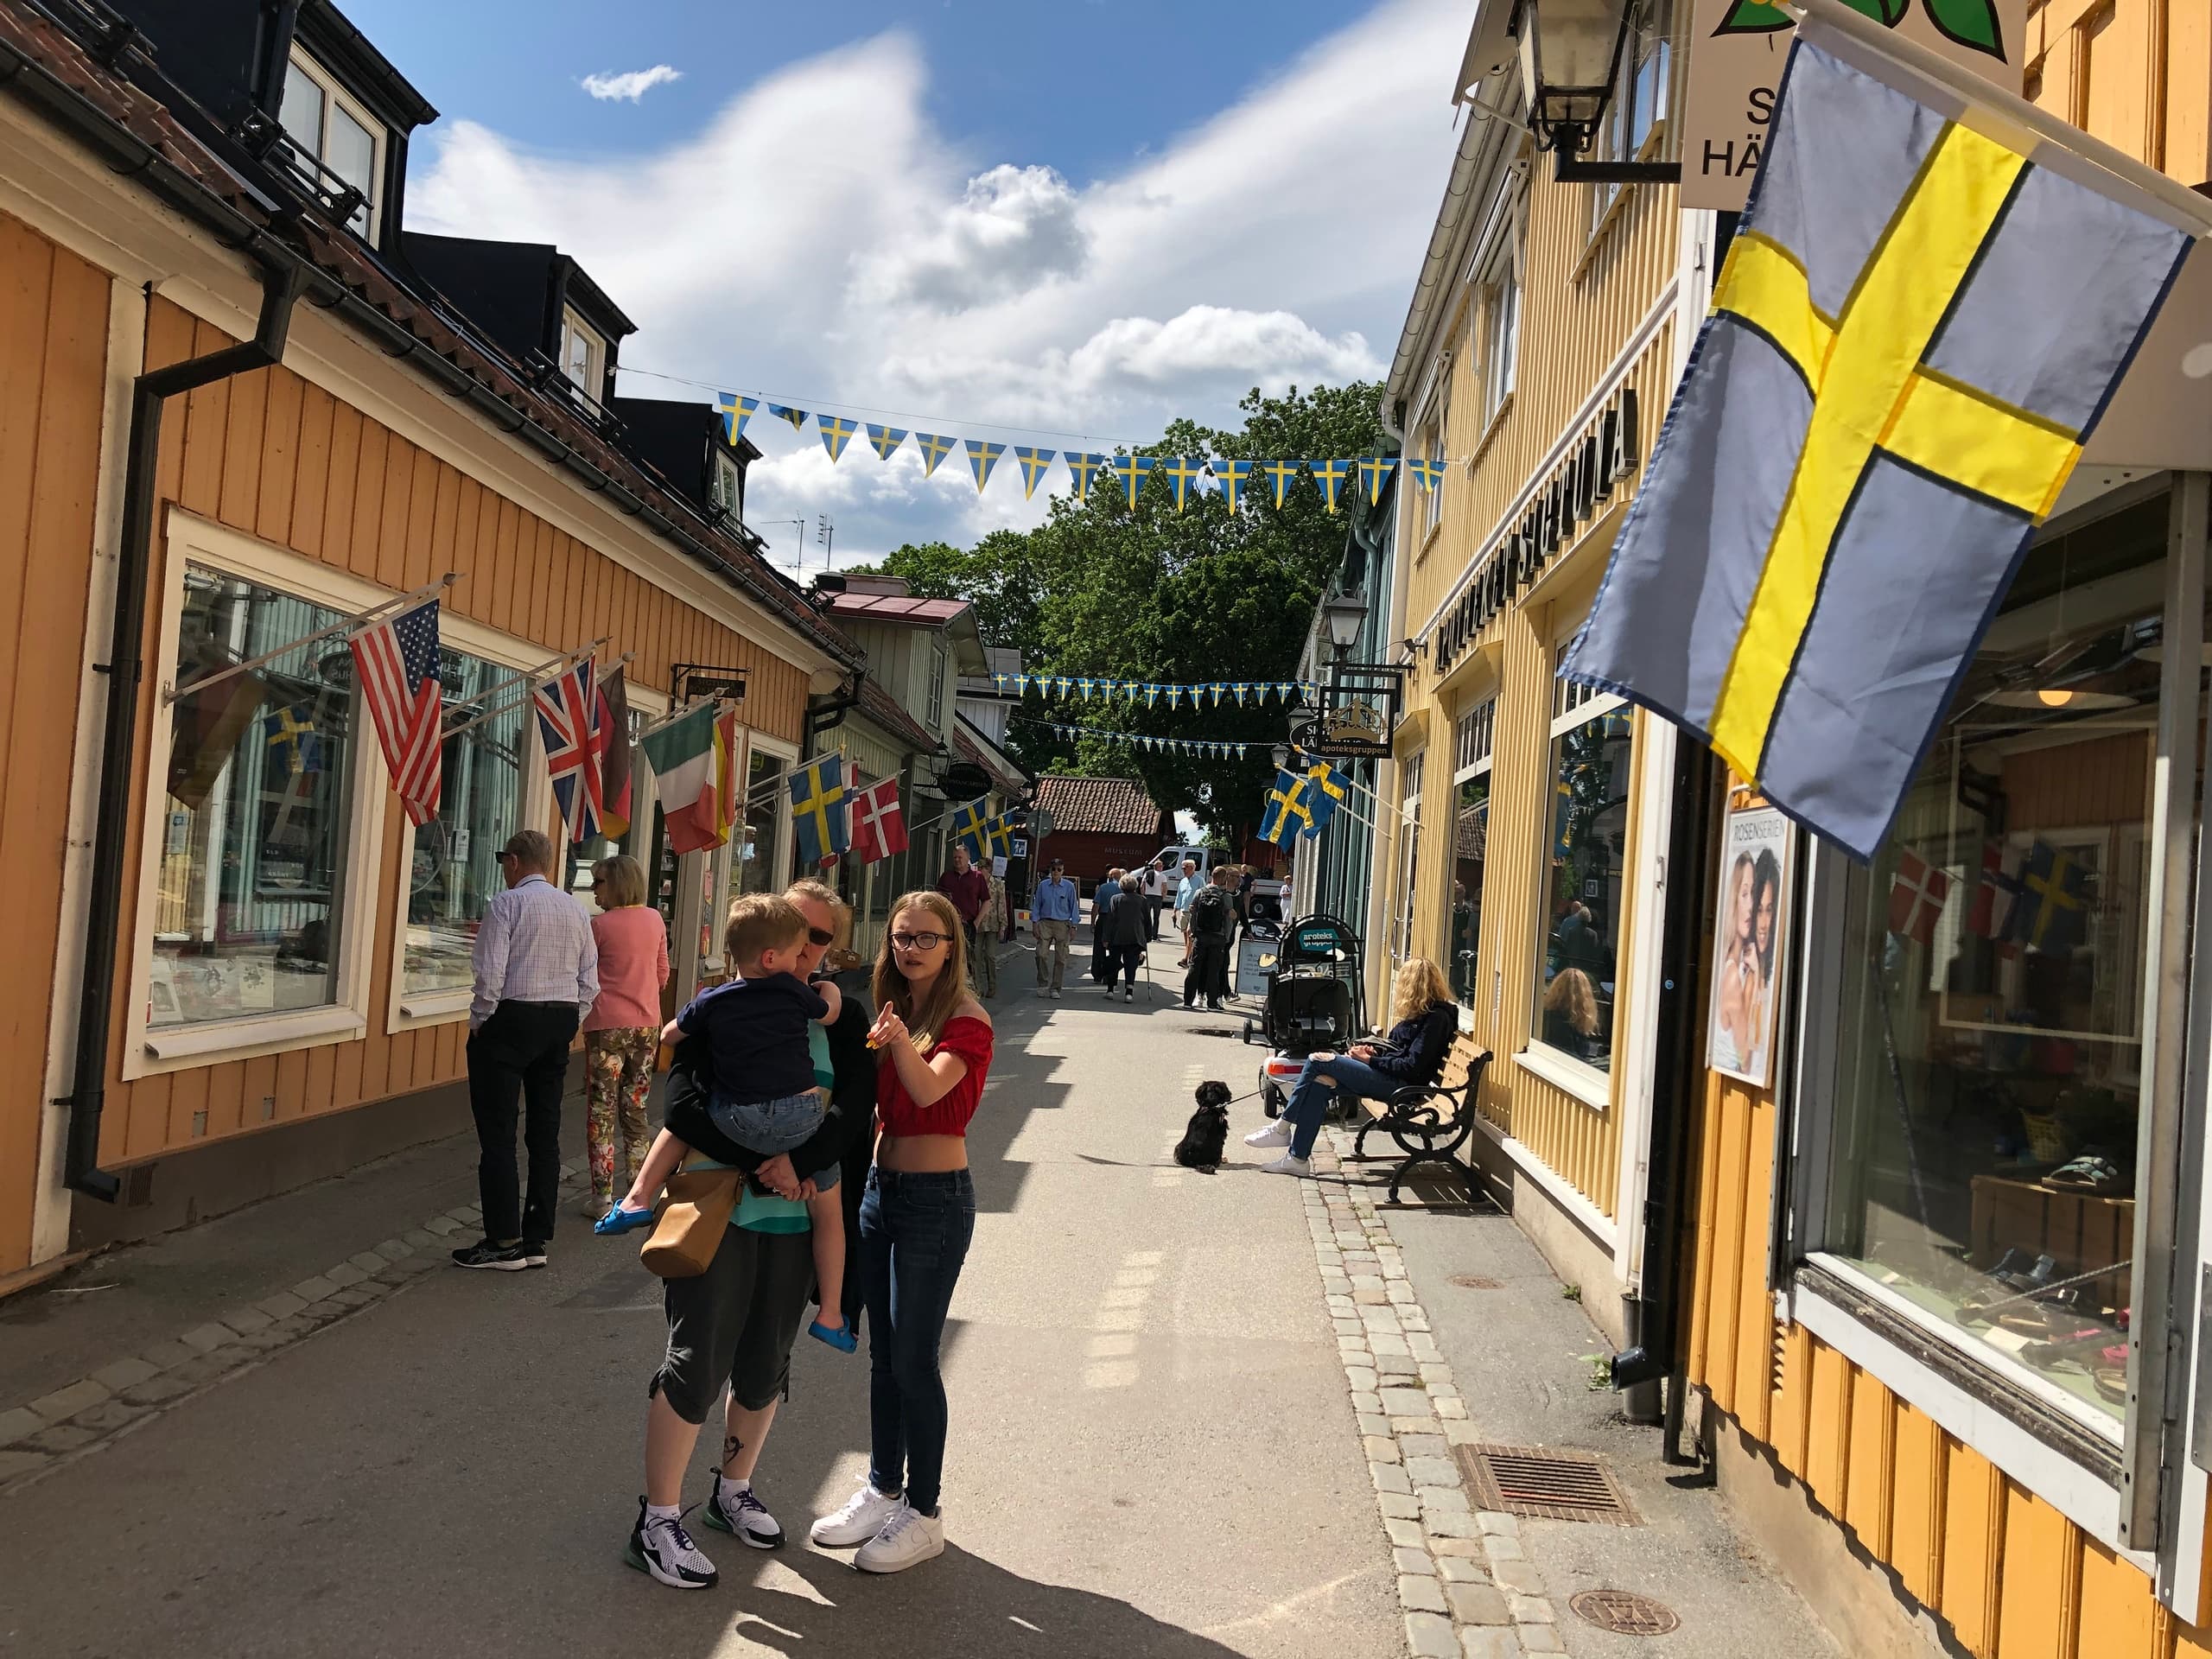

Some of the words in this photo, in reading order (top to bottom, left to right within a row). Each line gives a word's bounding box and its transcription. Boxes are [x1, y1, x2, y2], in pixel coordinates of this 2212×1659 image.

[1747, 87, 1776, 124] S
[1702, 133, 1762, 177] HÄ
[1518, 388, 1639, 585] SIGTUNA
[1321, 744, 1388, 755] apoteksgruppen
[1104, 847, 1142, 856] MUSEUM
